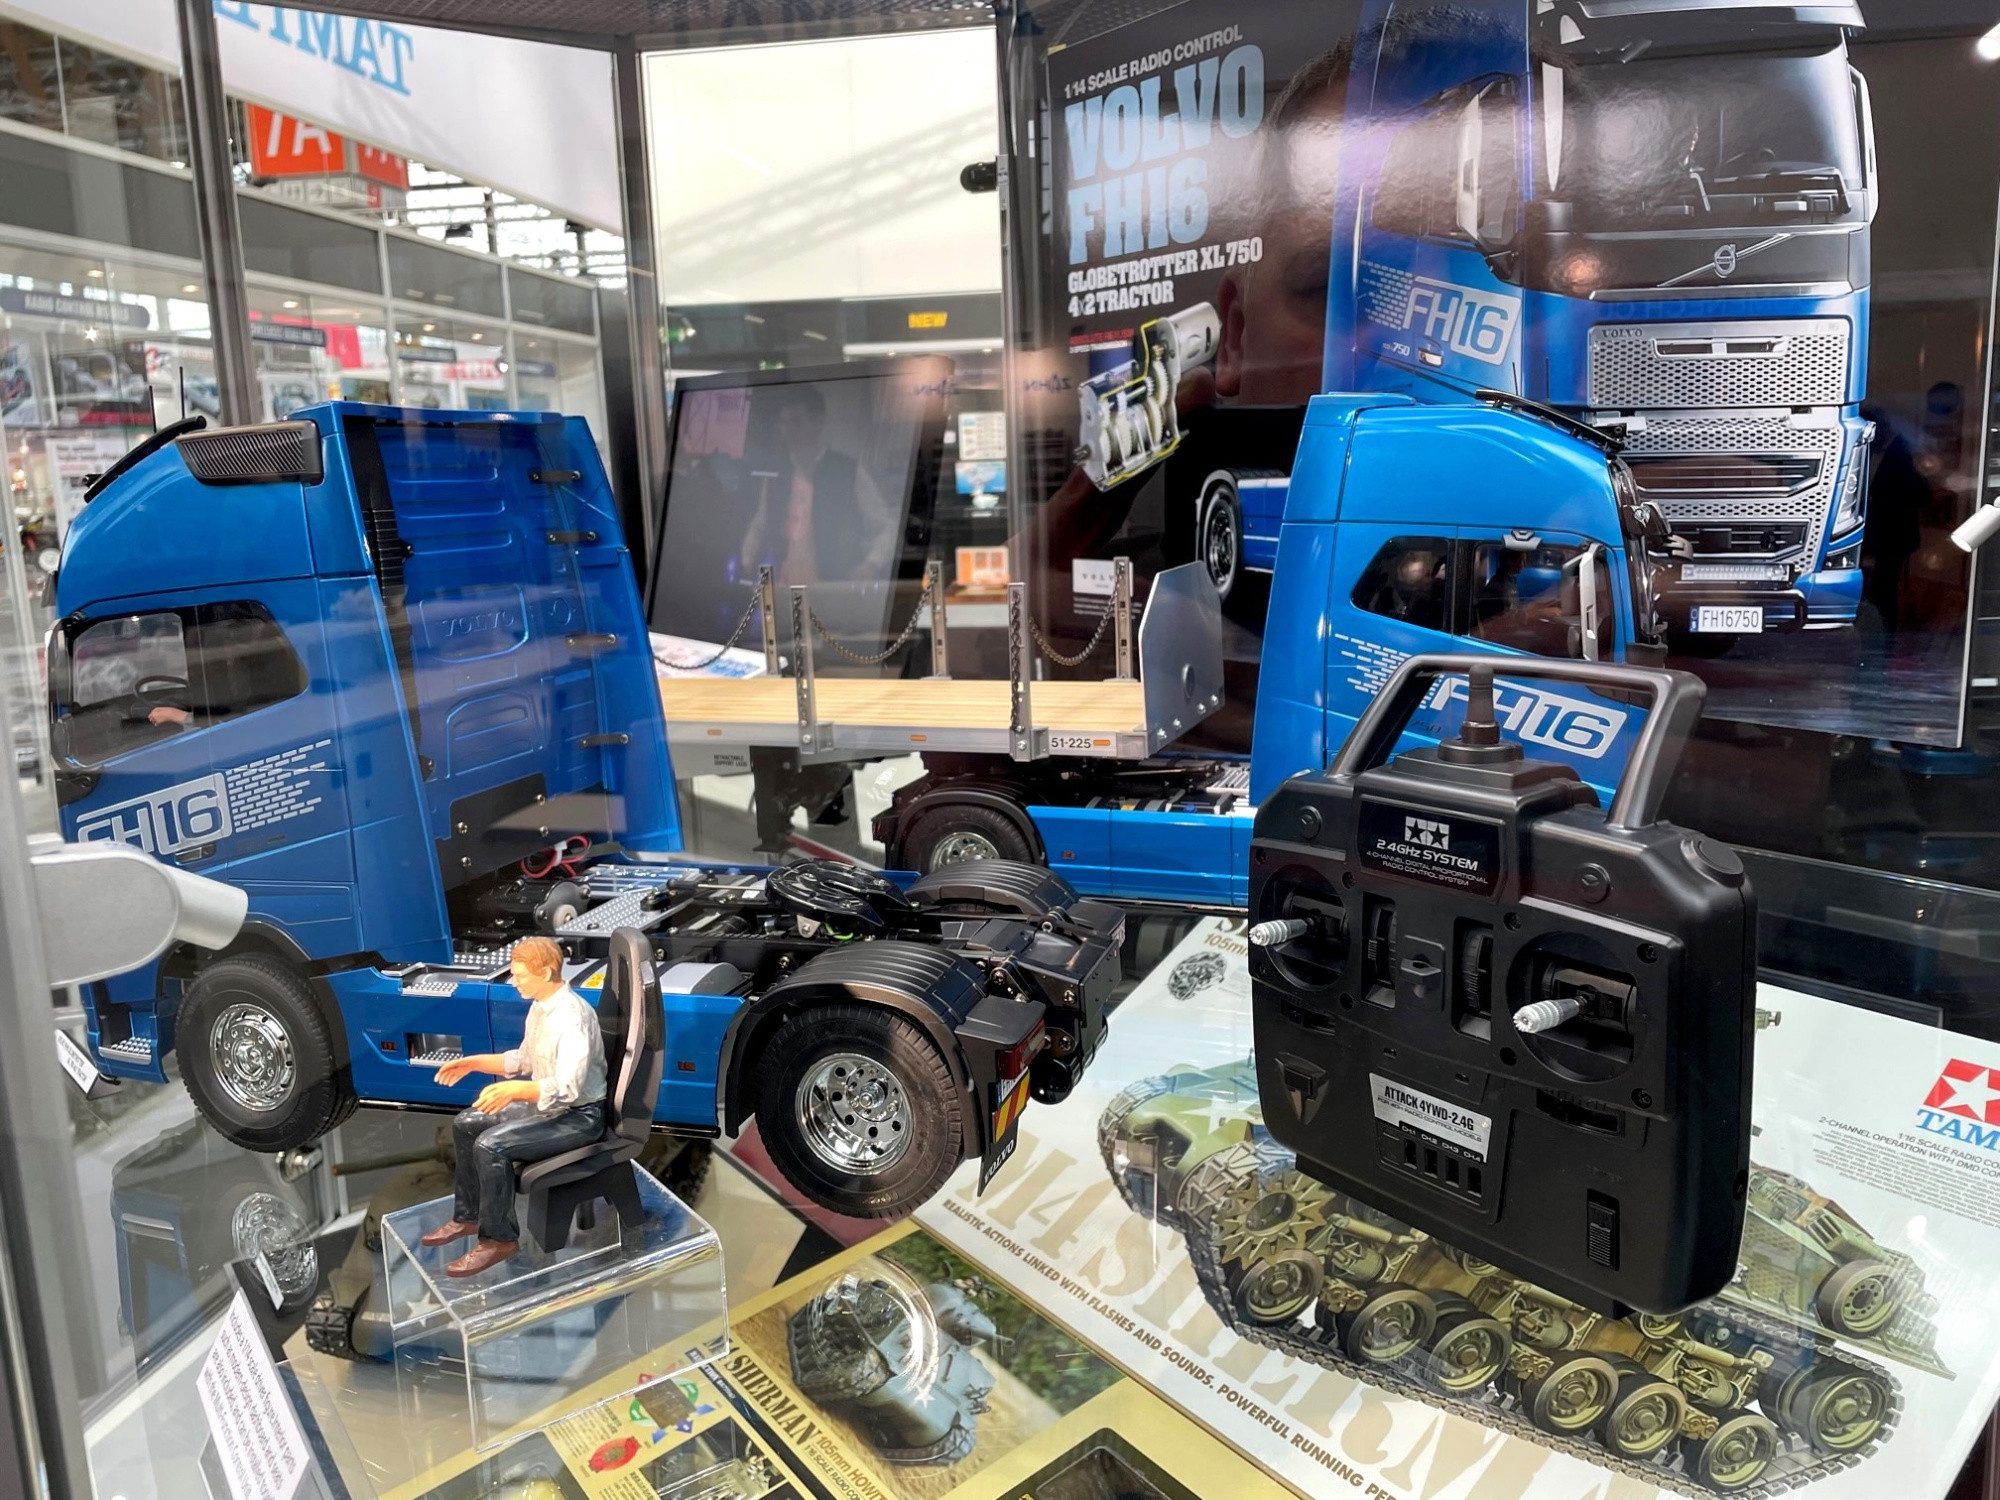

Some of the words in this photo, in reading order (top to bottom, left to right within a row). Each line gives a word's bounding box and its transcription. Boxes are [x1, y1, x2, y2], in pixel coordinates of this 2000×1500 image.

[1087, 63, 1129, 91] SCALE
[1129, 49, 1172, 78] RADIO
[1173, 24, 1243, 62] CONTROL
[1064, 44, 1265, 180] VOLVO
[1067, 157, 1209, 265] FH16
[1067, 249, 1199, 294] GLOBETROTTER
[1226, 237, 1263, 267] 750
[1096, 280, 1175, 314] TRACTOR
[1403, 287, 1509, 355] FH16
[1601, 328, 1643, 338] VOLVO
[1702, 610, 1759, 628] FH16750
[77, 789, 223, 853] FH16
[1382, 860, 1404, 871] RADIO
[1404, 866, 1438, 879] CONTROL
[1439, 873, 1470, 886] SYSTEM
[1405, 859, 1431, 870] DIGITAL
[1431, 865, 1489, 885] PROPORTIONAL
[1422, 850, 1479, 871] SYSTEM
[1384, 1085, 1419, 1110] ATTACK
[1419, 1099, 1475, 1131] 4YWD-2.4G
[1423, 1114, 1456, 1132] CONTROL
[1915, 1108, 2000, 1151] TAM
[984, 1139, 1014, 1184] VOLVO
[1818, 1115, 1872, 1138] 2-CHANNEL
[1873, 1133, 1928, 1156] OPERATION
[1928, 1150, 1955, 1165] WITH
[1956, 1160, 1980, 1174] DMD
[1916, 1135, 1950, 1154] SCALE
[1951, 1148, 1983, 1164] RADIO
[1983, 1158, 2000, 1171] CO
[942, 1199, 987, 1232] REALISTIC
[983, 1226, 1029, 1258] ACTIONS
[1023, 1250, 1060, 1283] LINKED
[1059, 1275, 1091, 1304] WITH
[1087, 1294, 1137, 1333] FLASHES
[1132, 1326, 1162, 1352] AND
[1160, 1345, 1215, 1390] SOUNDS.
[1216, 1383, 1291, 1440] POWERFUL
[1290, 1432, 1365, 1488] RUNNING
[724, 1354, 822, 1445] SHERMAN
[816, 1435, 852, 1473] 105mm
[813, 1454, 835, 1474] SCALE
[830, 1471, 851, 1491] RADIO
